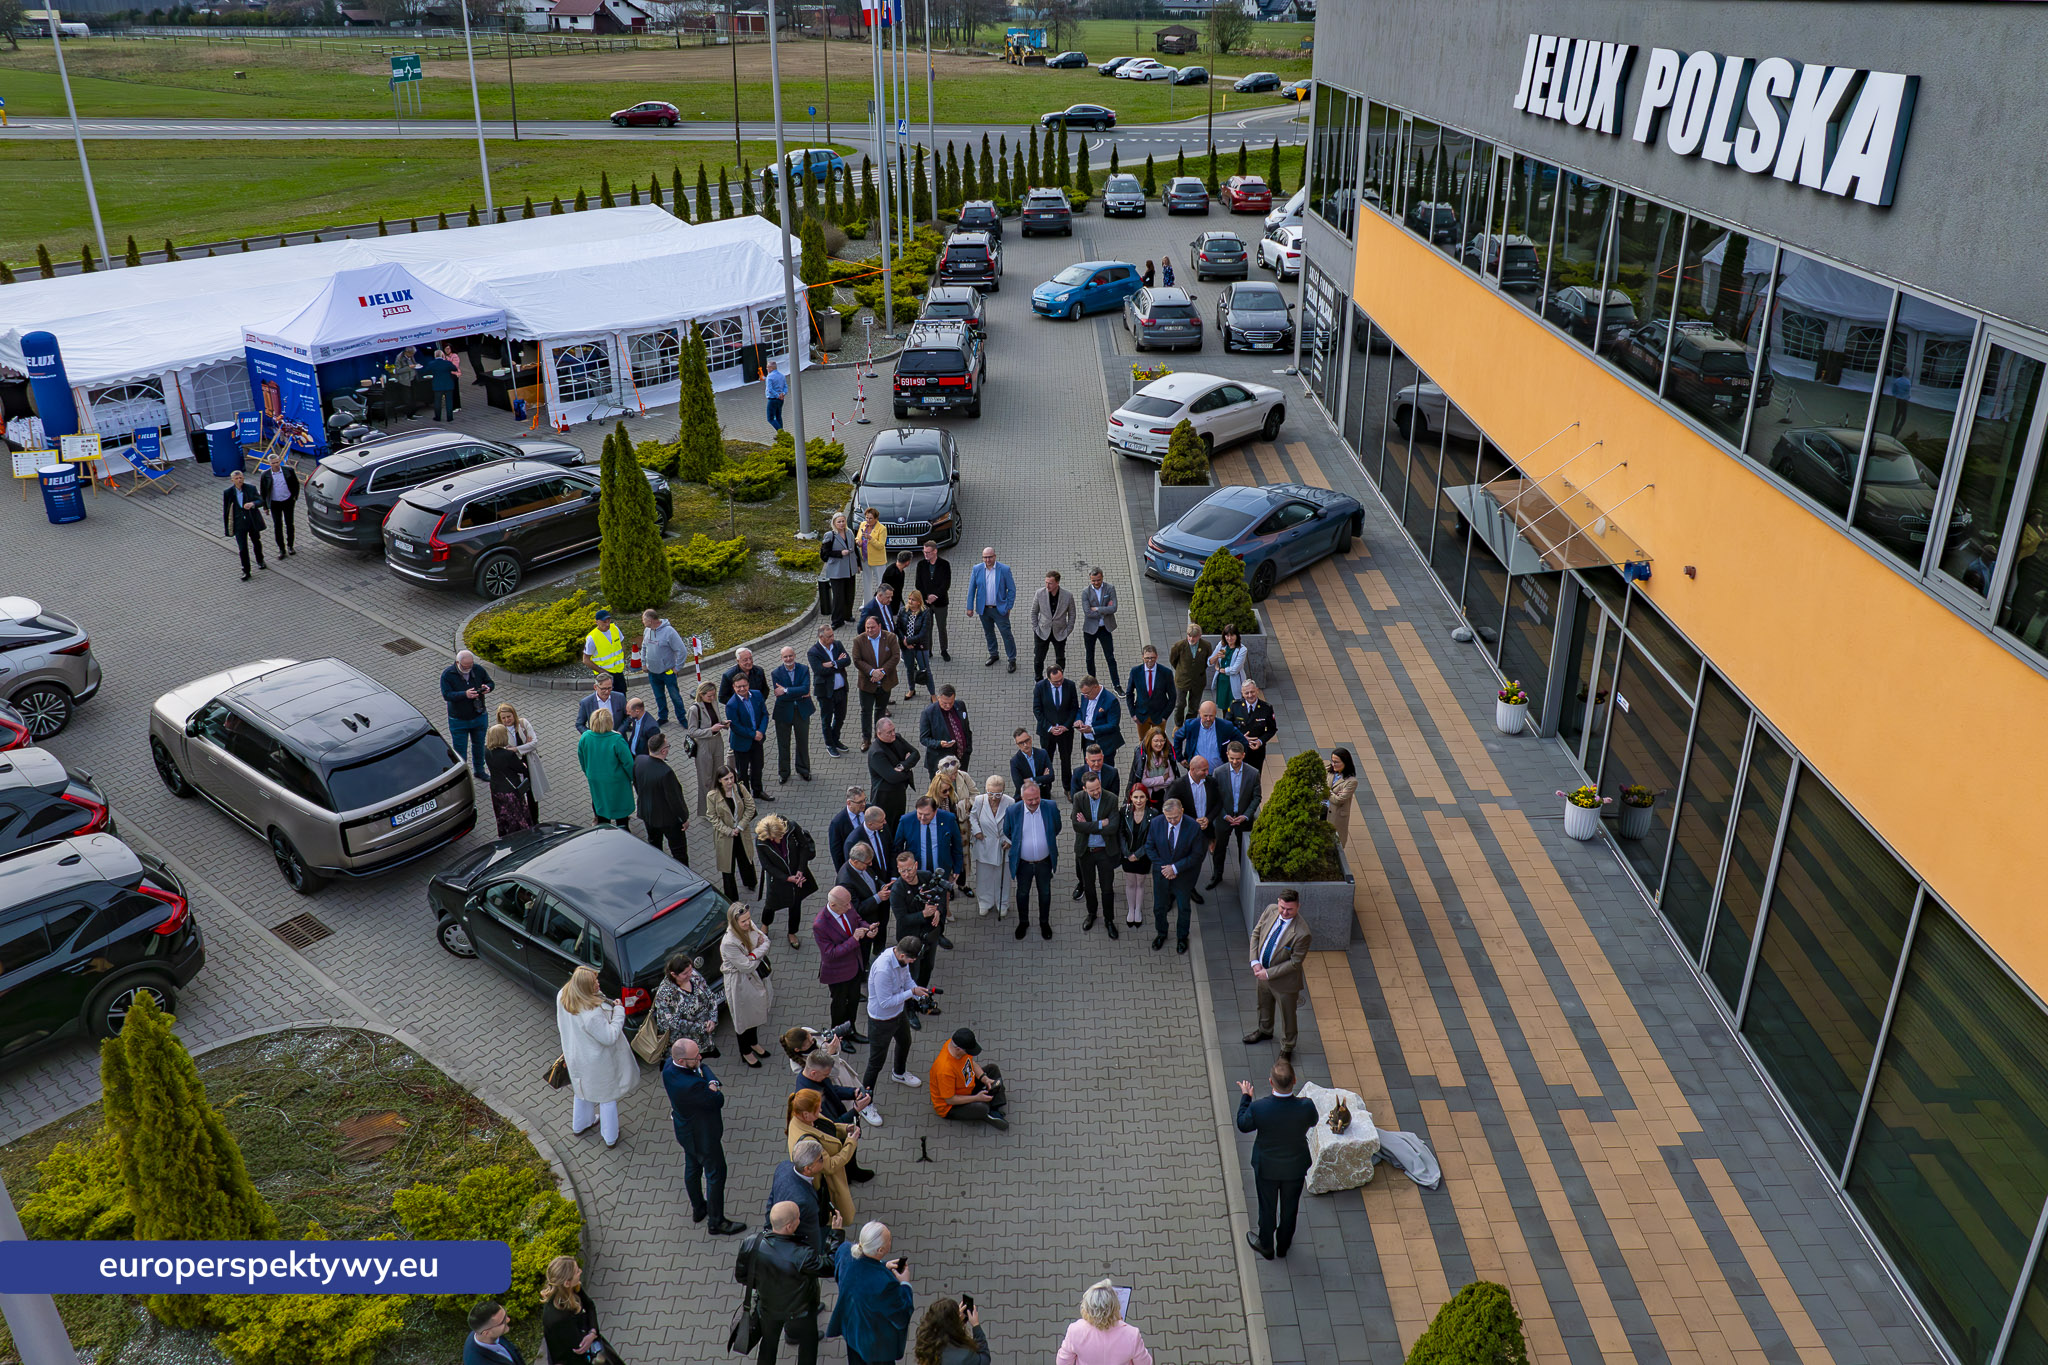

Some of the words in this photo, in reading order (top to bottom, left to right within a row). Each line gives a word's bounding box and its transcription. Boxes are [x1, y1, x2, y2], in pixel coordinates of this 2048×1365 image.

[1513, 34, 1632, 135] JELUX
[1632, 47, 1910, 207] POLSKA
[368, 289, 413, 306] JELUX
[383, 306, 410, 316] JELUX
[48, 474, 76, 486] JELUX
[396, 812, 408, 823] SK
[410, 800, 435, 818] 6F708
